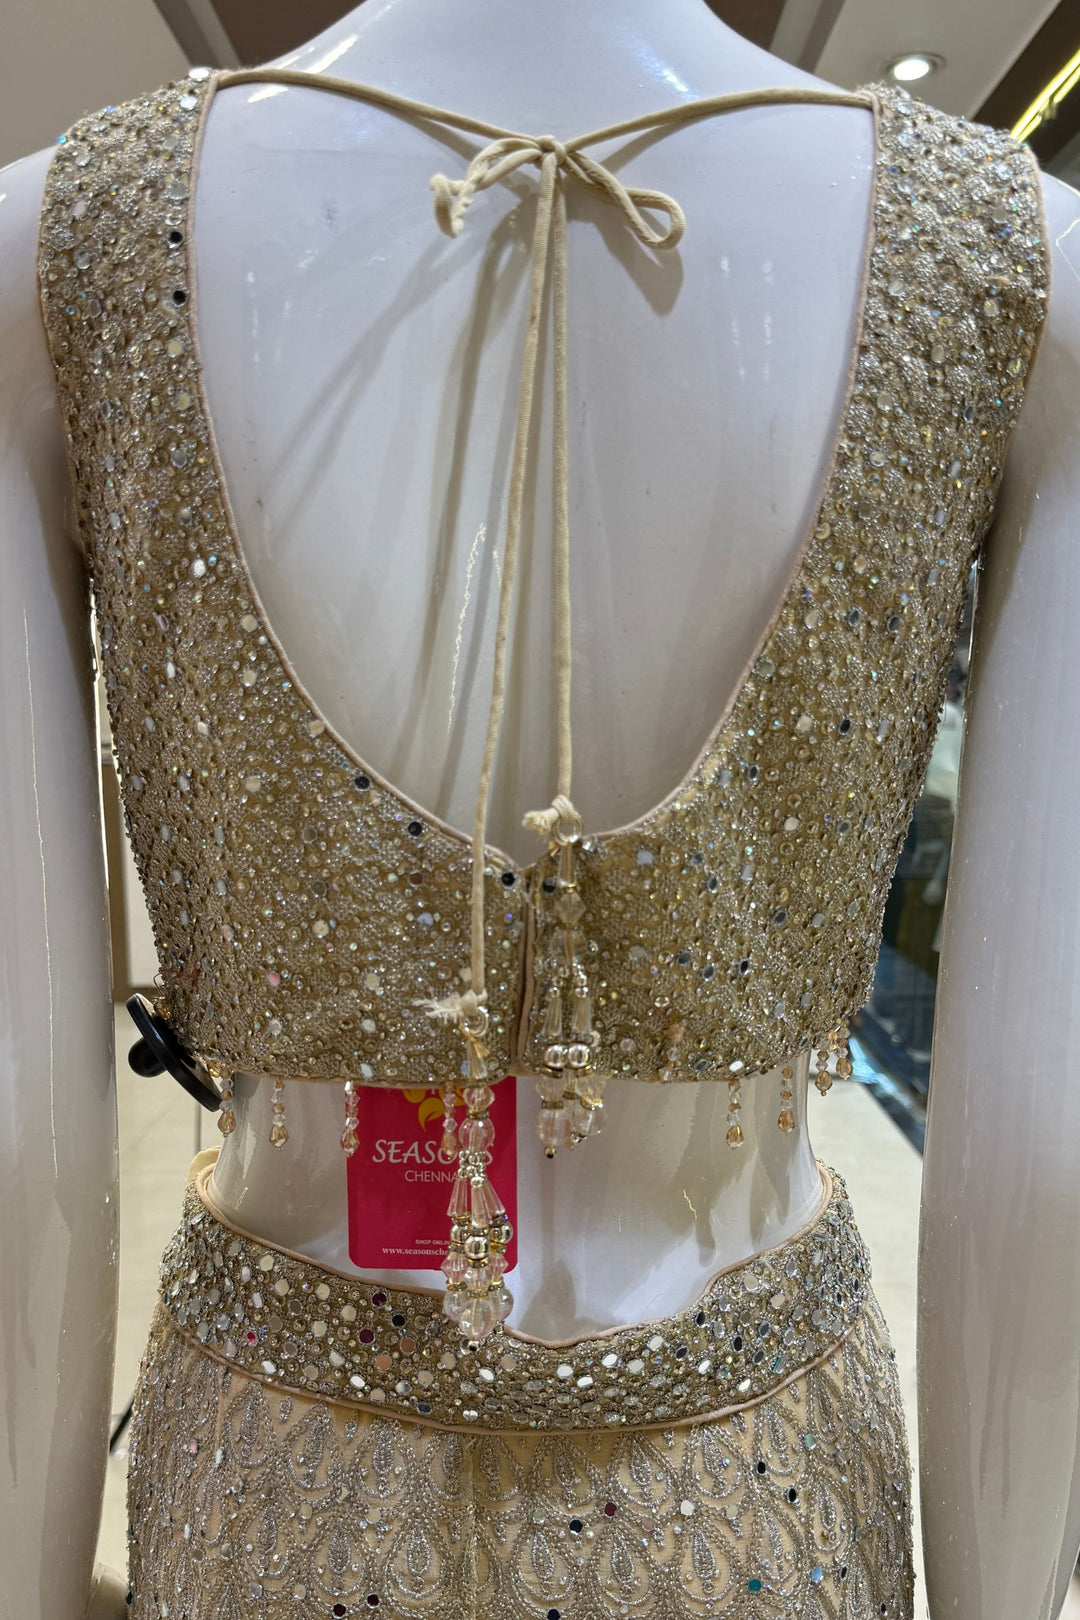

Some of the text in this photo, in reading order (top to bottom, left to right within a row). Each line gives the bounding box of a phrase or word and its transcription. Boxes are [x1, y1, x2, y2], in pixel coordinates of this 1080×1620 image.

[372, 1139, 494, 1165] SEASOS
[404, 1170, 462, 1182] CHENNA
[382, 1247, 449, 1256] www.seasonsche
